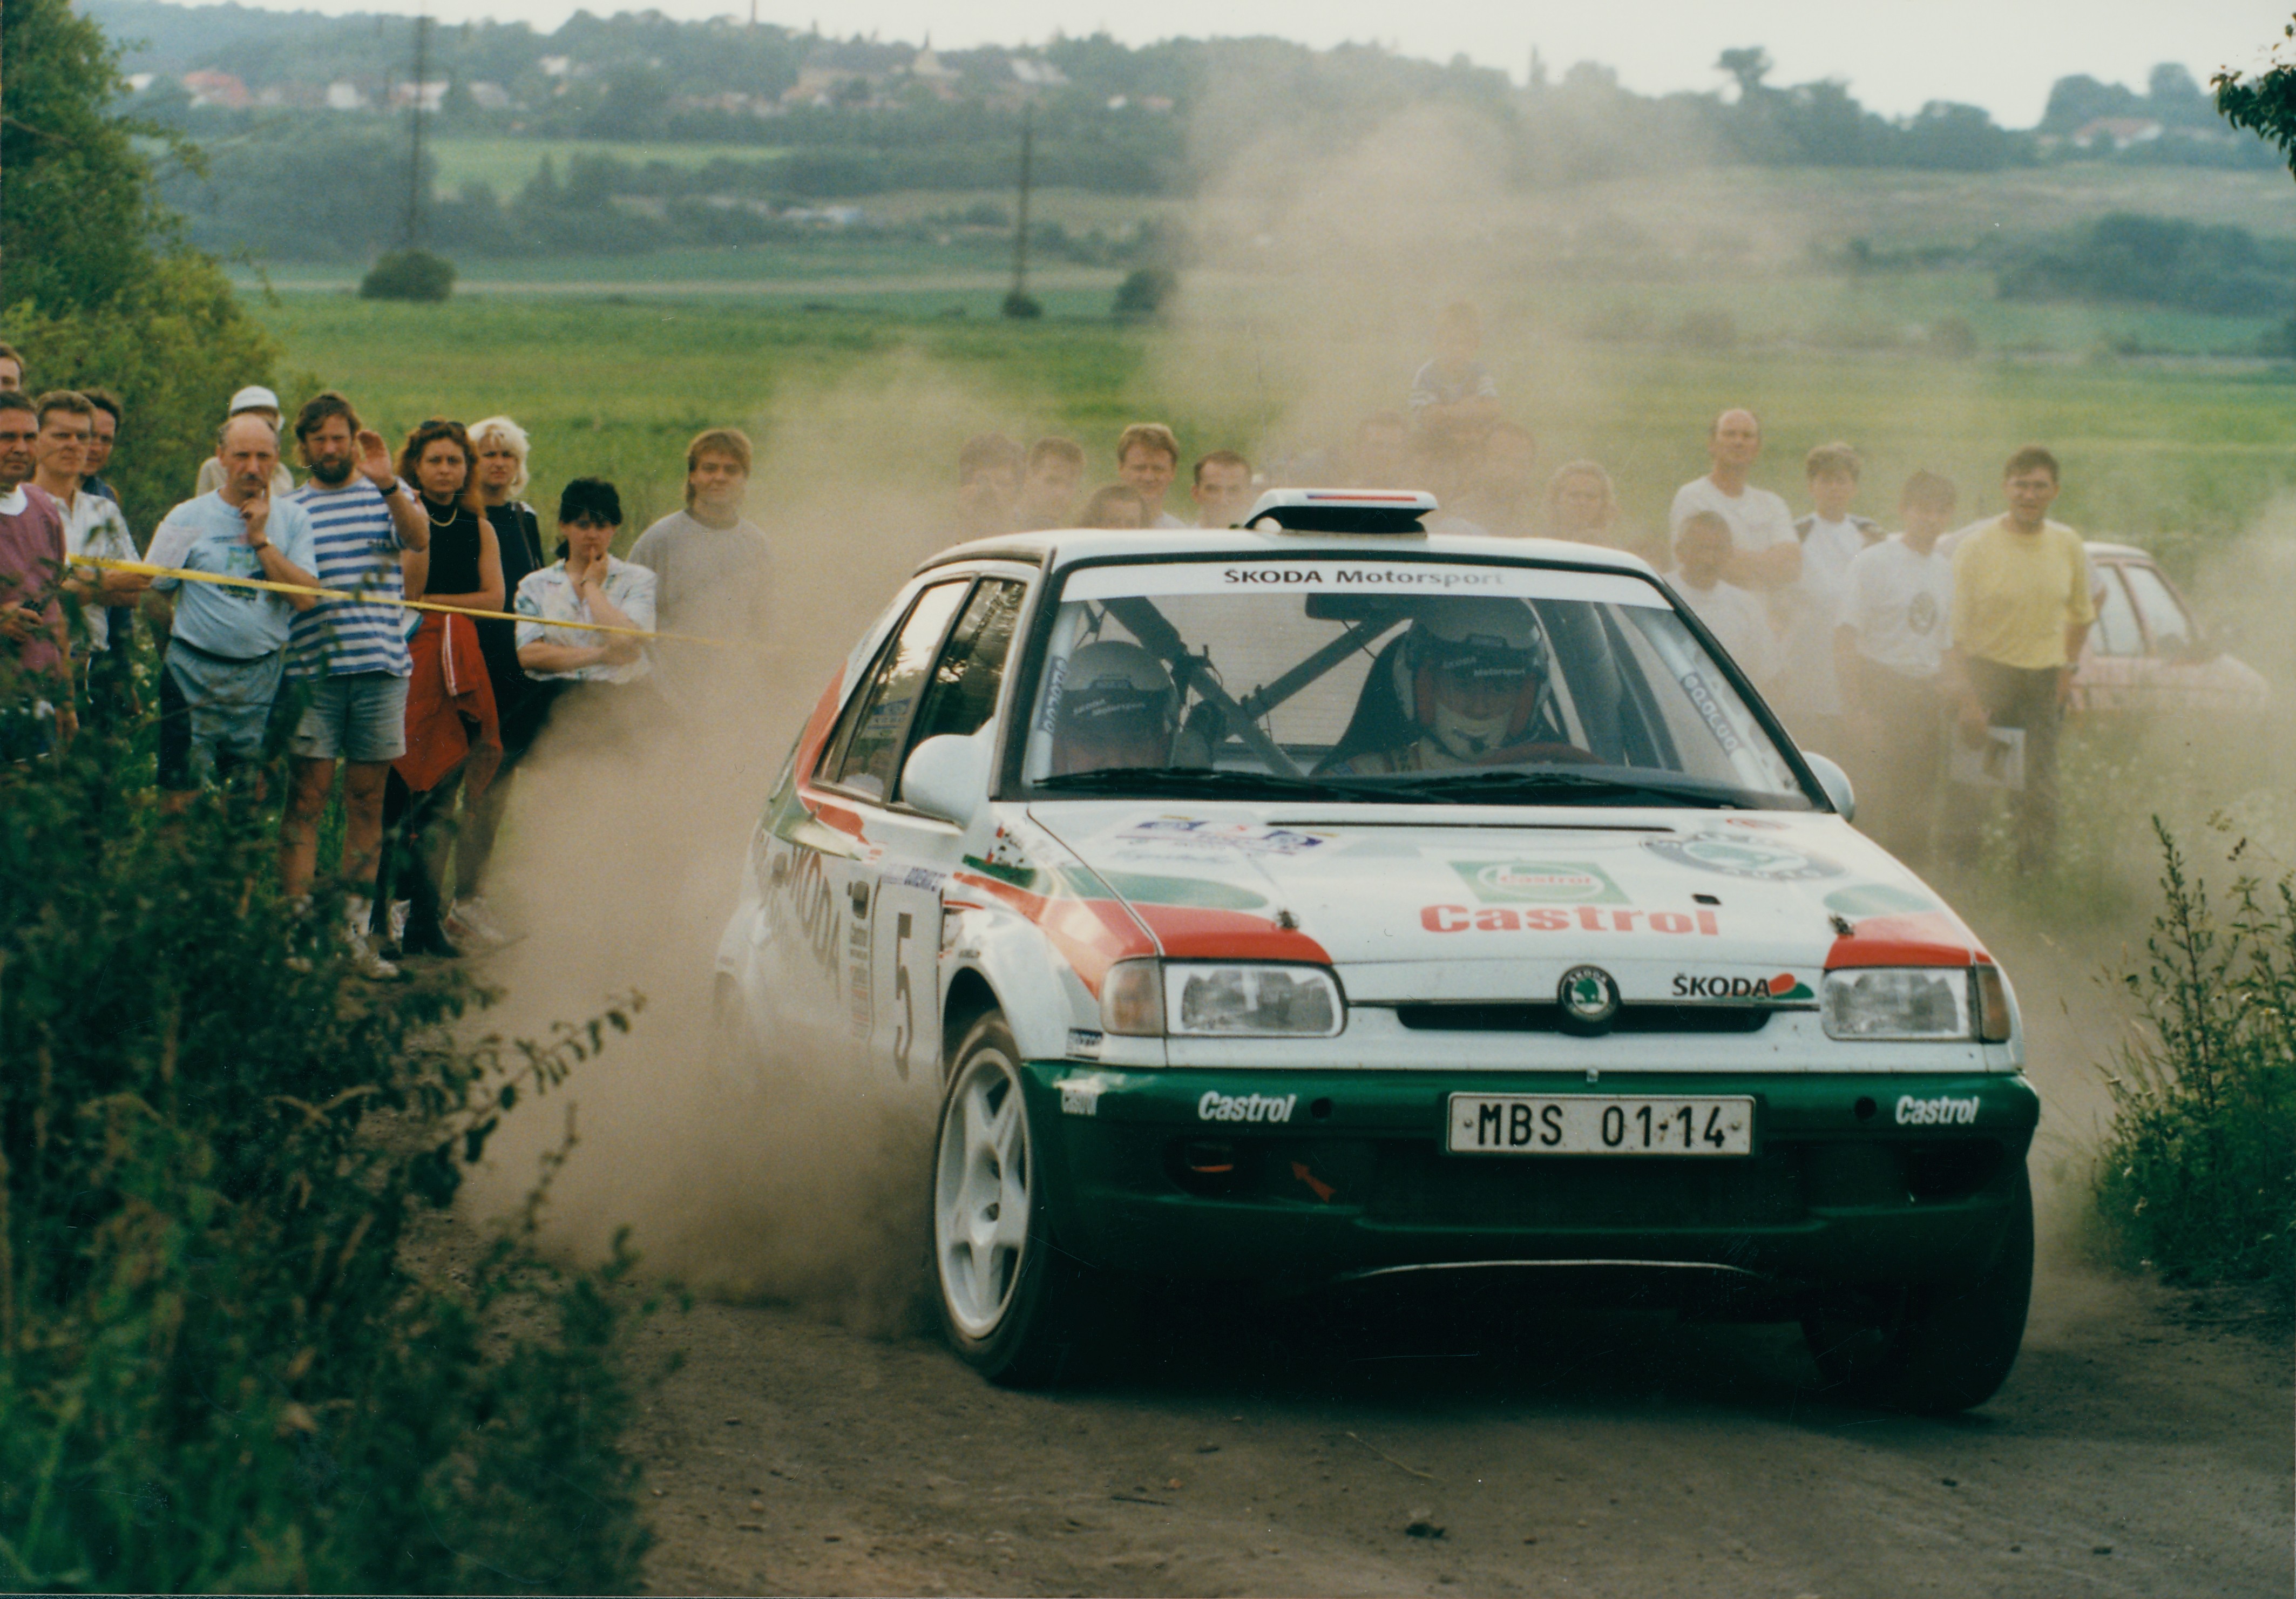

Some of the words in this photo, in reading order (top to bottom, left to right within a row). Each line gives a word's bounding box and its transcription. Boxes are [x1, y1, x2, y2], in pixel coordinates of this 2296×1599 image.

[1224, 570, 1323, 584] ŠKODA
[1336, 570, 1505, 588] Motorsport
[1499, 873, 1593, 886] Castrol
[1420, 904, 1719, 936] Castrol
[894, 912, 913, 1083] 5
[1672, 973, 1771, 997] ŠKODA
[1197, 1089, 1297, 1123] Castrol
[1895, 1094, 1980, 1125] Castrol
[1478, 1103, 1563, 1147] MBS
